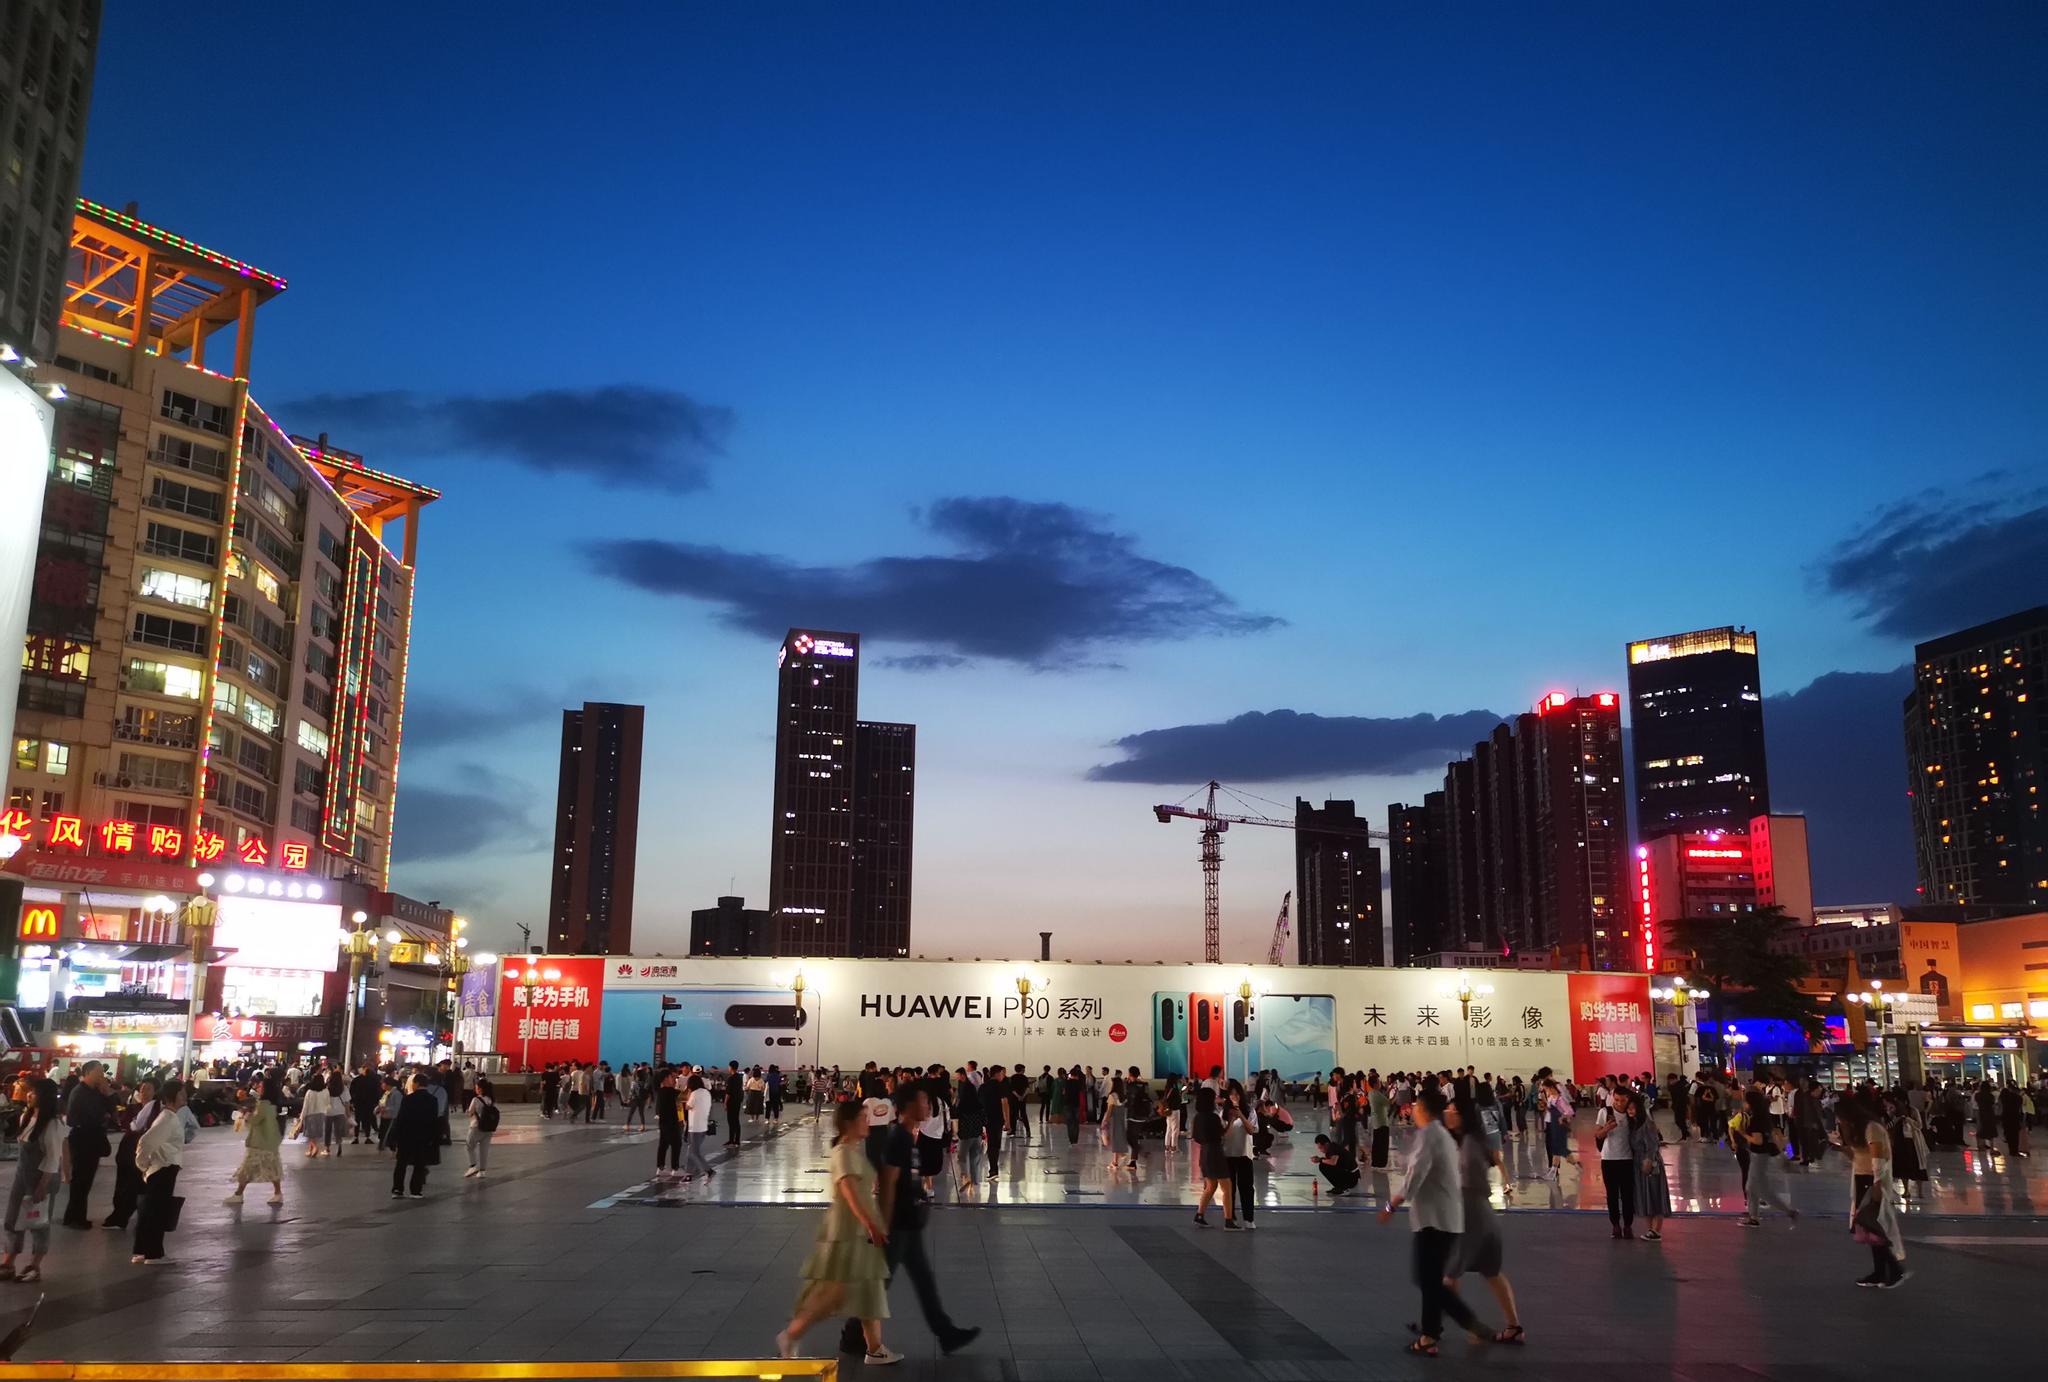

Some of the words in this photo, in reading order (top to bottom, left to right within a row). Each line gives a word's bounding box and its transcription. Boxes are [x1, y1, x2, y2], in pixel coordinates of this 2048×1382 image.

[120, 872, 185, 888] 手机连锁
[513, 986, 589, 1007] 购华为手机
[860, 994, 992, 1019] HUAWEI
[1003, 997, 1050, 1020] P30
[1058, 997, 1103, 1020] 系列
[1363, 1003, 1544, 1029] 未来影像
[1580, 1001, 1641, 1022] 购华为手机
[518, 1018, 580, 1040] 到迪信通
[1056, 1026, 1102, 1037] 联合设计
[1364, 1034, 1450, 1046] 超感光徕卡四摄
[1588, 1032, 1637, 1053] 到迪信通
